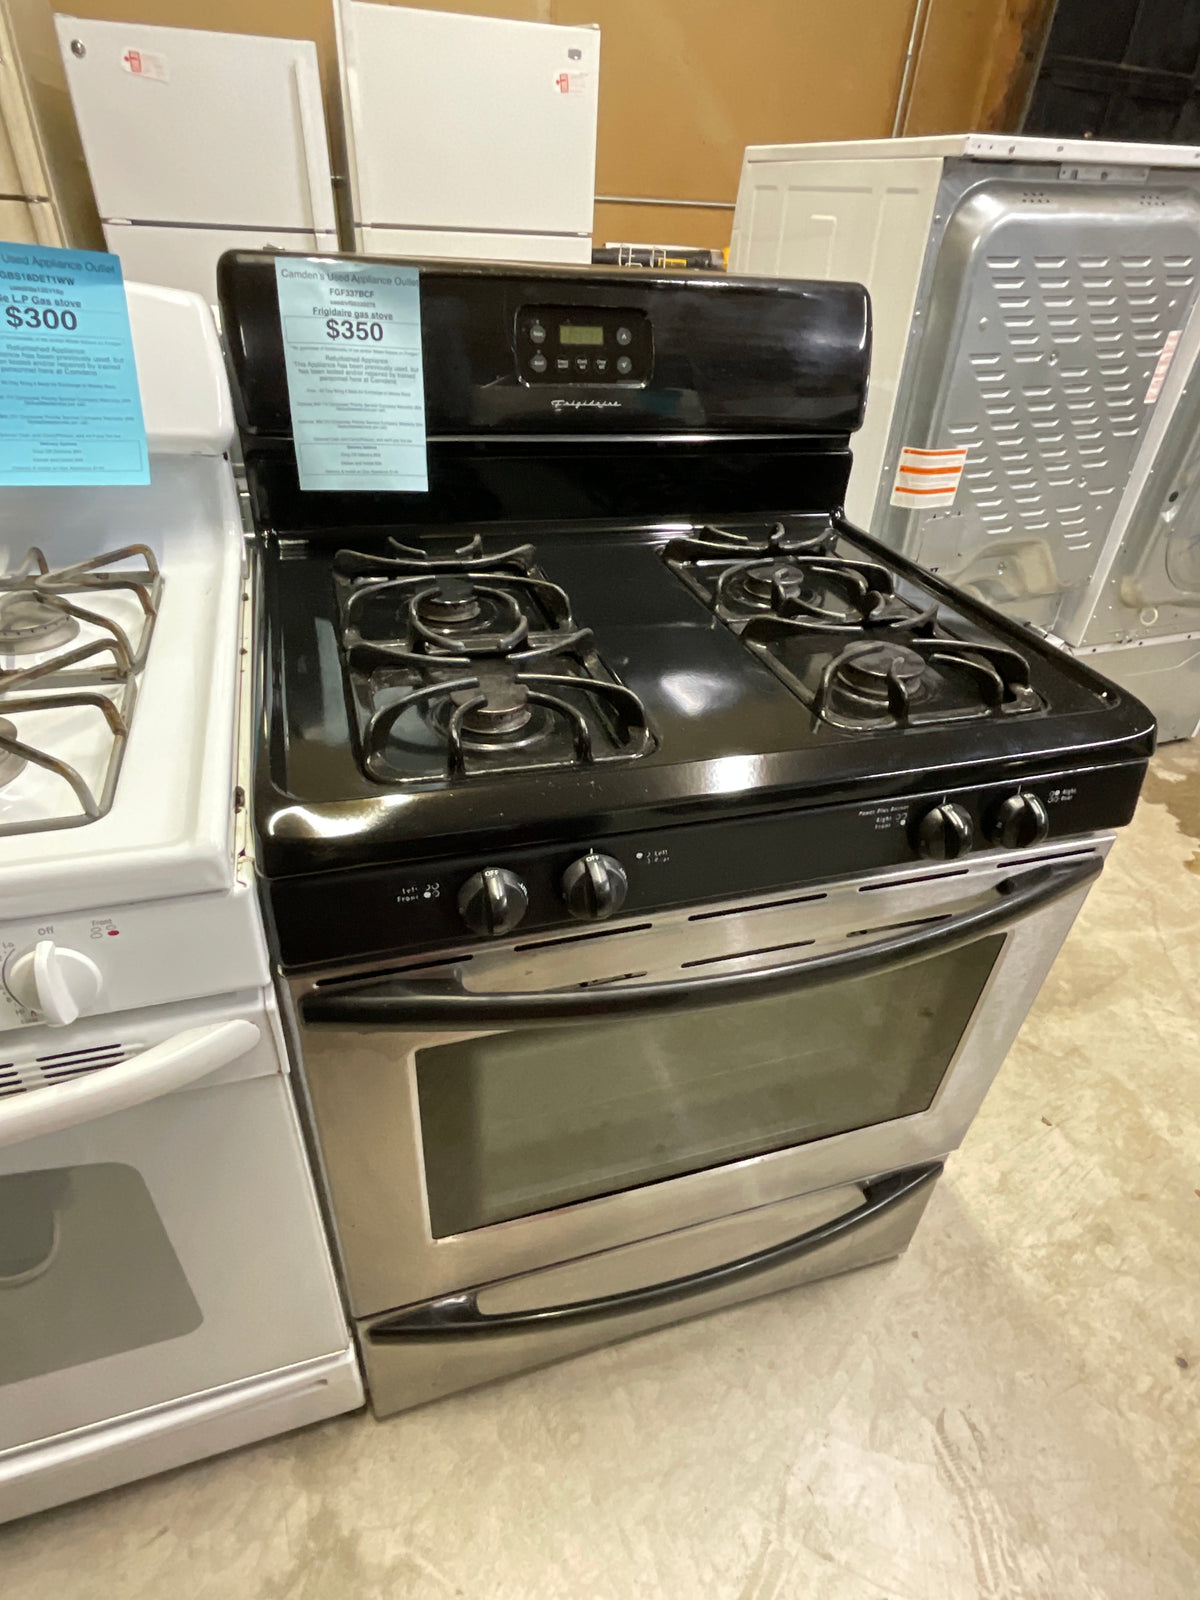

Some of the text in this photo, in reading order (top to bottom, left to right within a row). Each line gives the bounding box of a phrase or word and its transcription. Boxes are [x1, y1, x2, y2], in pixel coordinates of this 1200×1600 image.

[5, 305, 78, 331] $300
[312, 307, 394, 321] Frigidaire gas stove
[326, 318, 384, 341] $350
[550, 400, 622, 409] Frigidaire
[38, 926, 54, 936] Off
